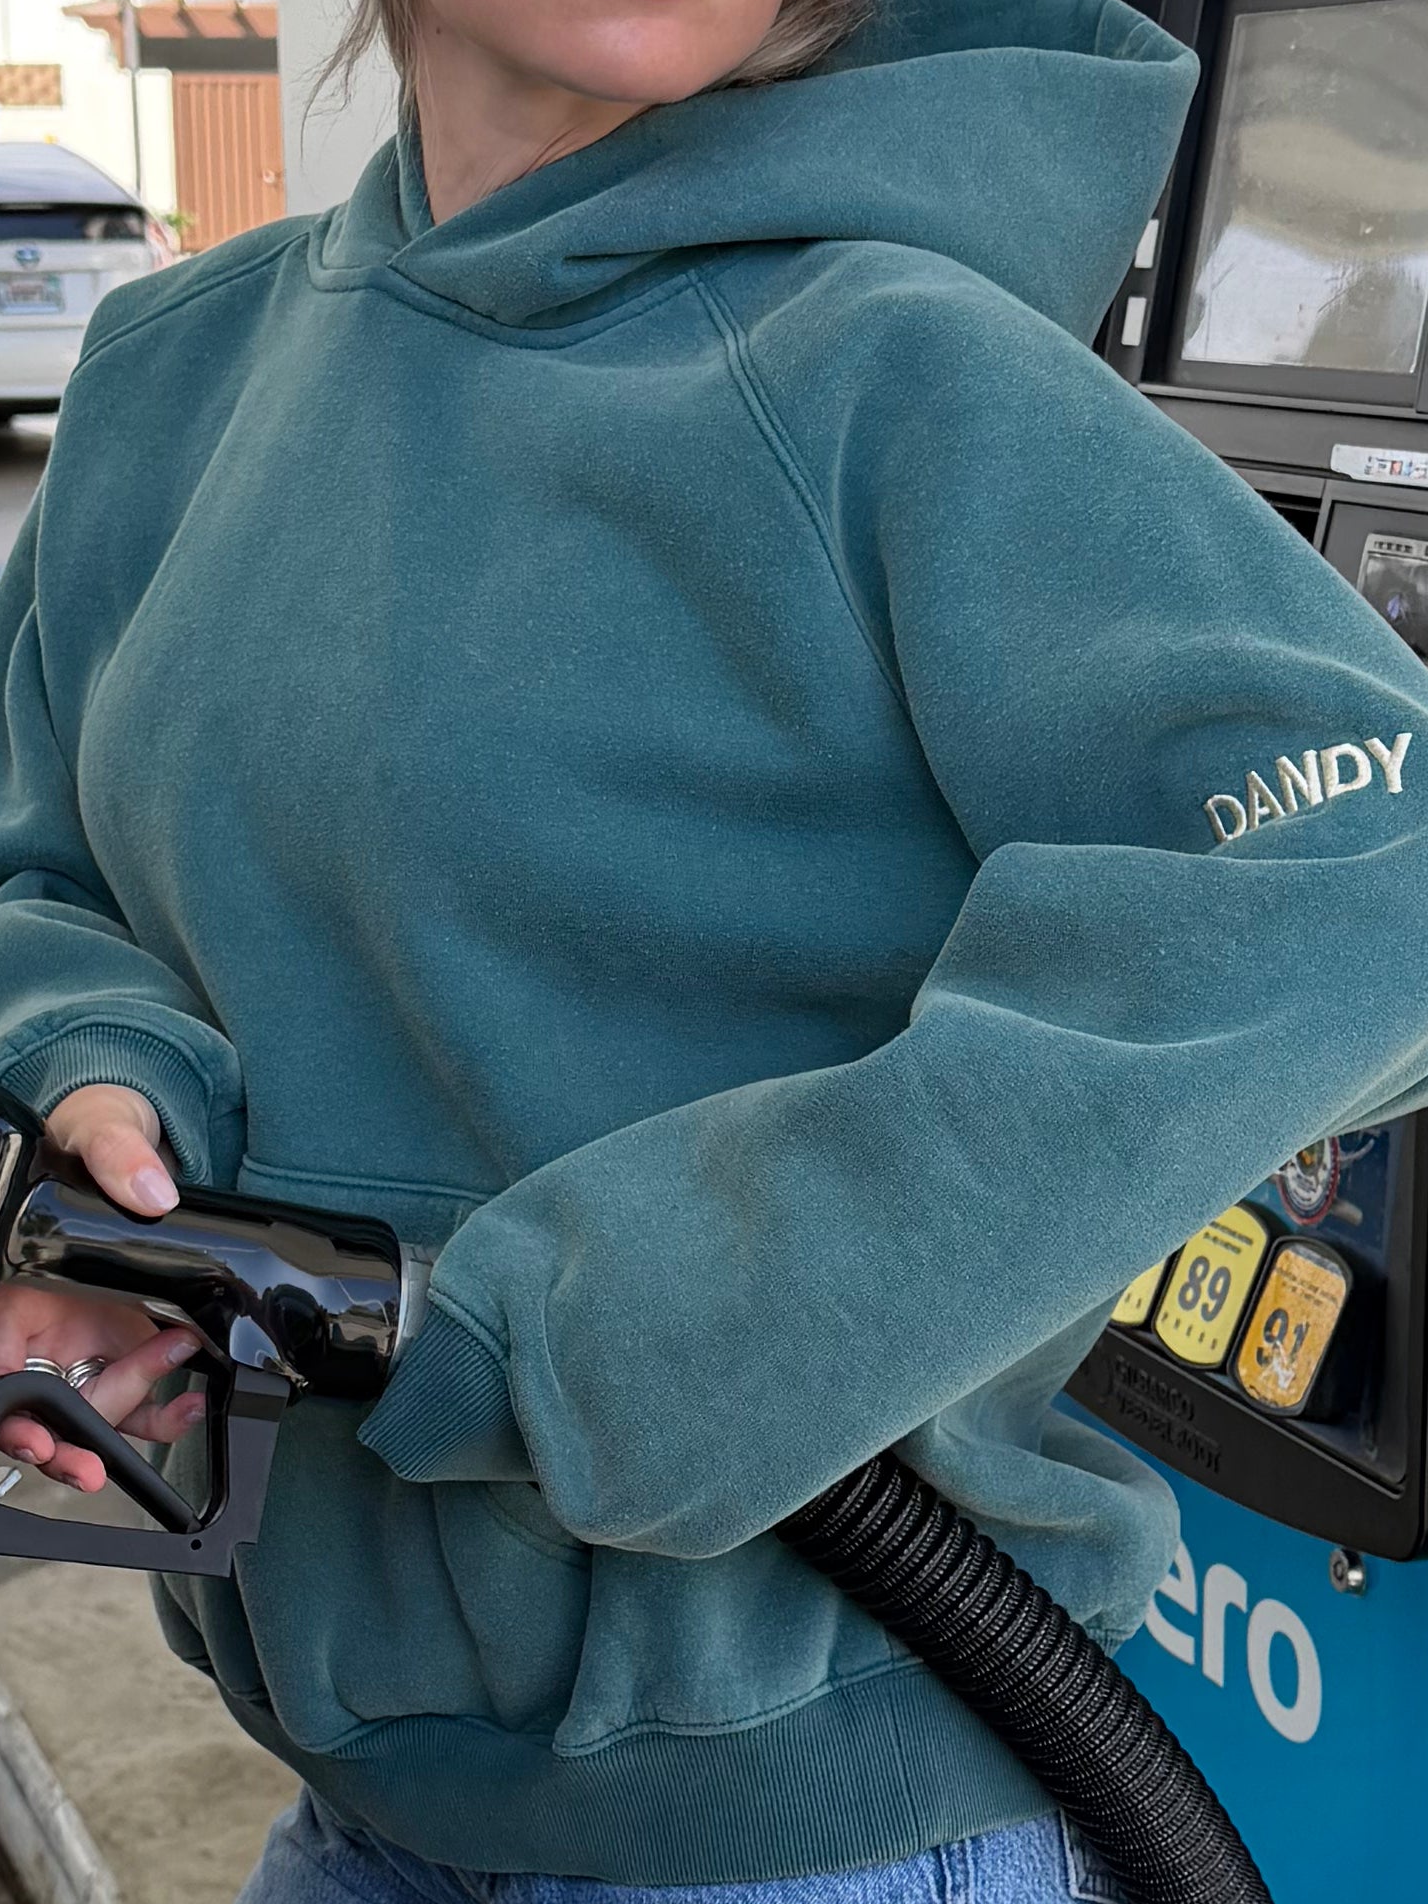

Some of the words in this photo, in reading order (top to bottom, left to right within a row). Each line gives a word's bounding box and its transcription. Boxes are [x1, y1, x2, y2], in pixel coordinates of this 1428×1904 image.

[1203, 732, 1413, 843] DANDY
[1177, 1255, 1231, 1322] 89
[1255, 1307, 1310, 1368] 91
